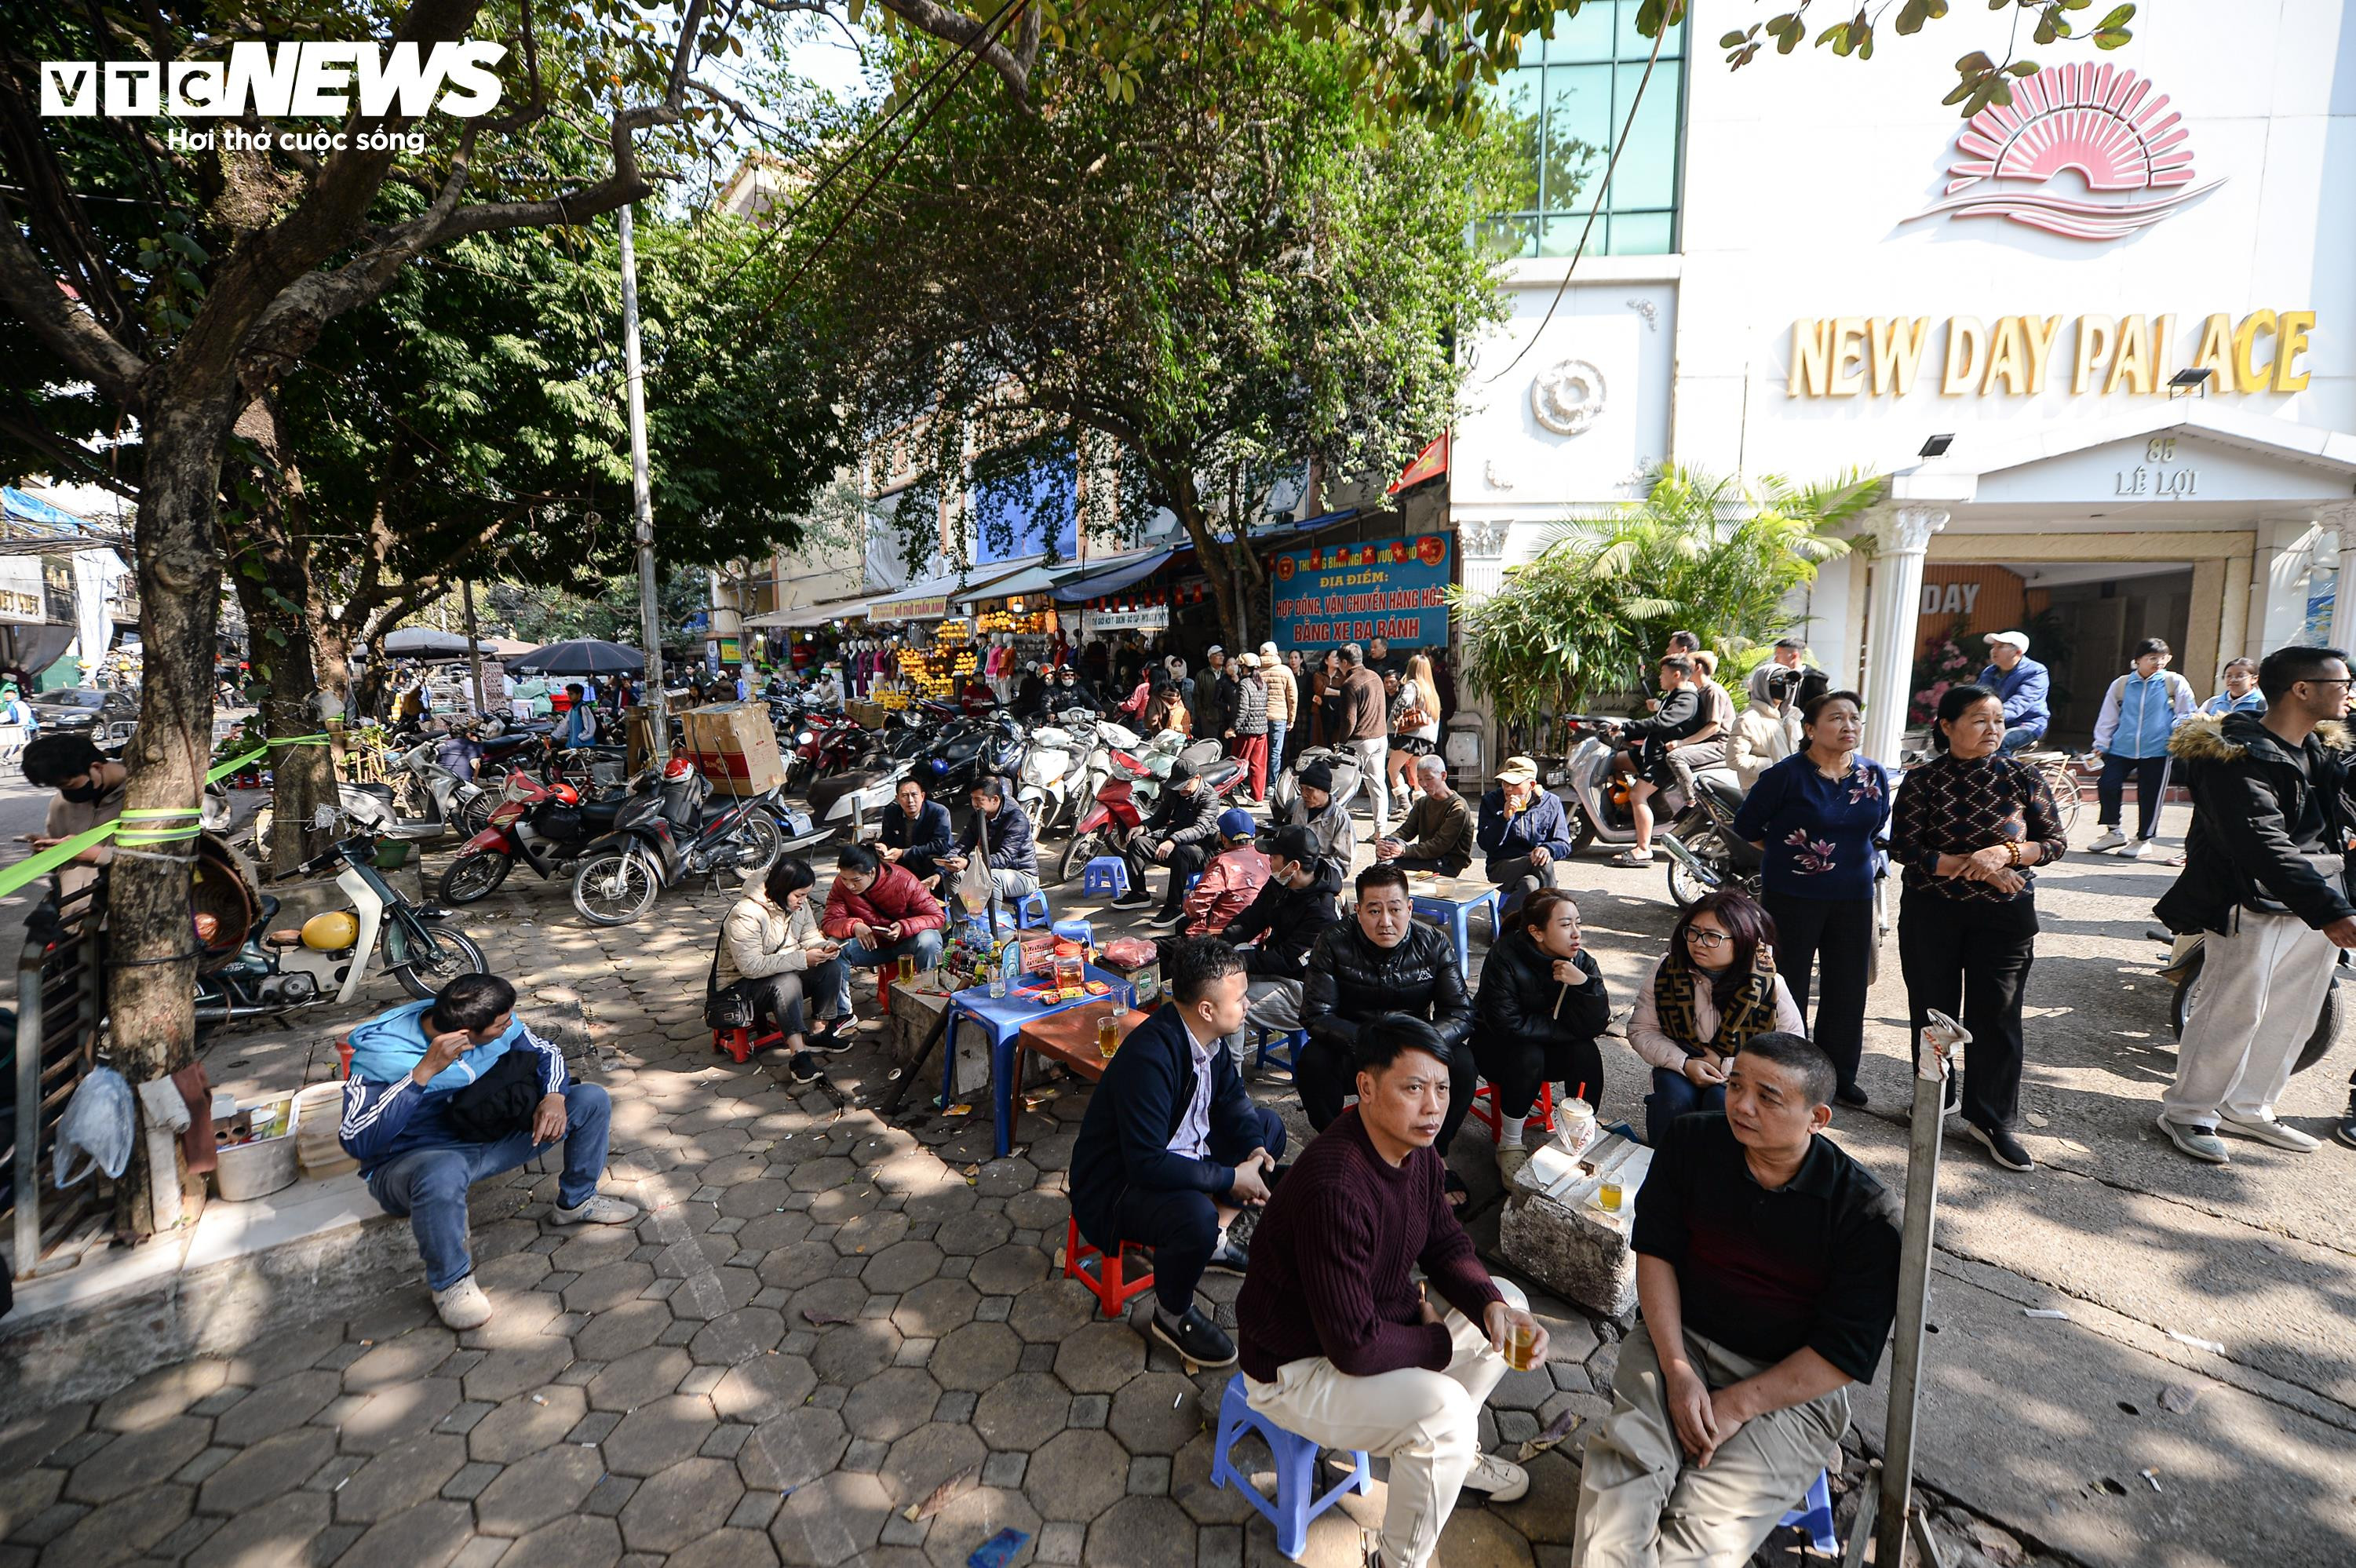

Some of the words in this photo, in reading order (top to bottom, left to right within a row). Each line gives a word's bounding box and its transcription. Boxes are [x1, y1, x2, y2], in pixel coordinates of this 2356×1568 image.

[1788, 315, 1931, 398] NEW
[1940, 314, 2064, 397] DAY
[2070, 308, 2317, 398] PALACE
[2146, 437, 2177, 463] 85
[2115, 465, 2148, 495] LÊ
[2156, 468, 2200, 500] LỢI
[1299, 556, 1327, 571] THG
[1377, 548, 1396, 565] VƯỢ
[1405, 542, 1417, 560] HÓ
[1320, 575, 1344, 589] ĐỊA
[1920, 583, 1981, 614] DAY
[1293, 617, 1330, 643] BẰNG
[1332, 622, 1351, 642] XE
[1353, 620, 1373, 641] BA
[1376, 614, 1420, 640] BÁNH
